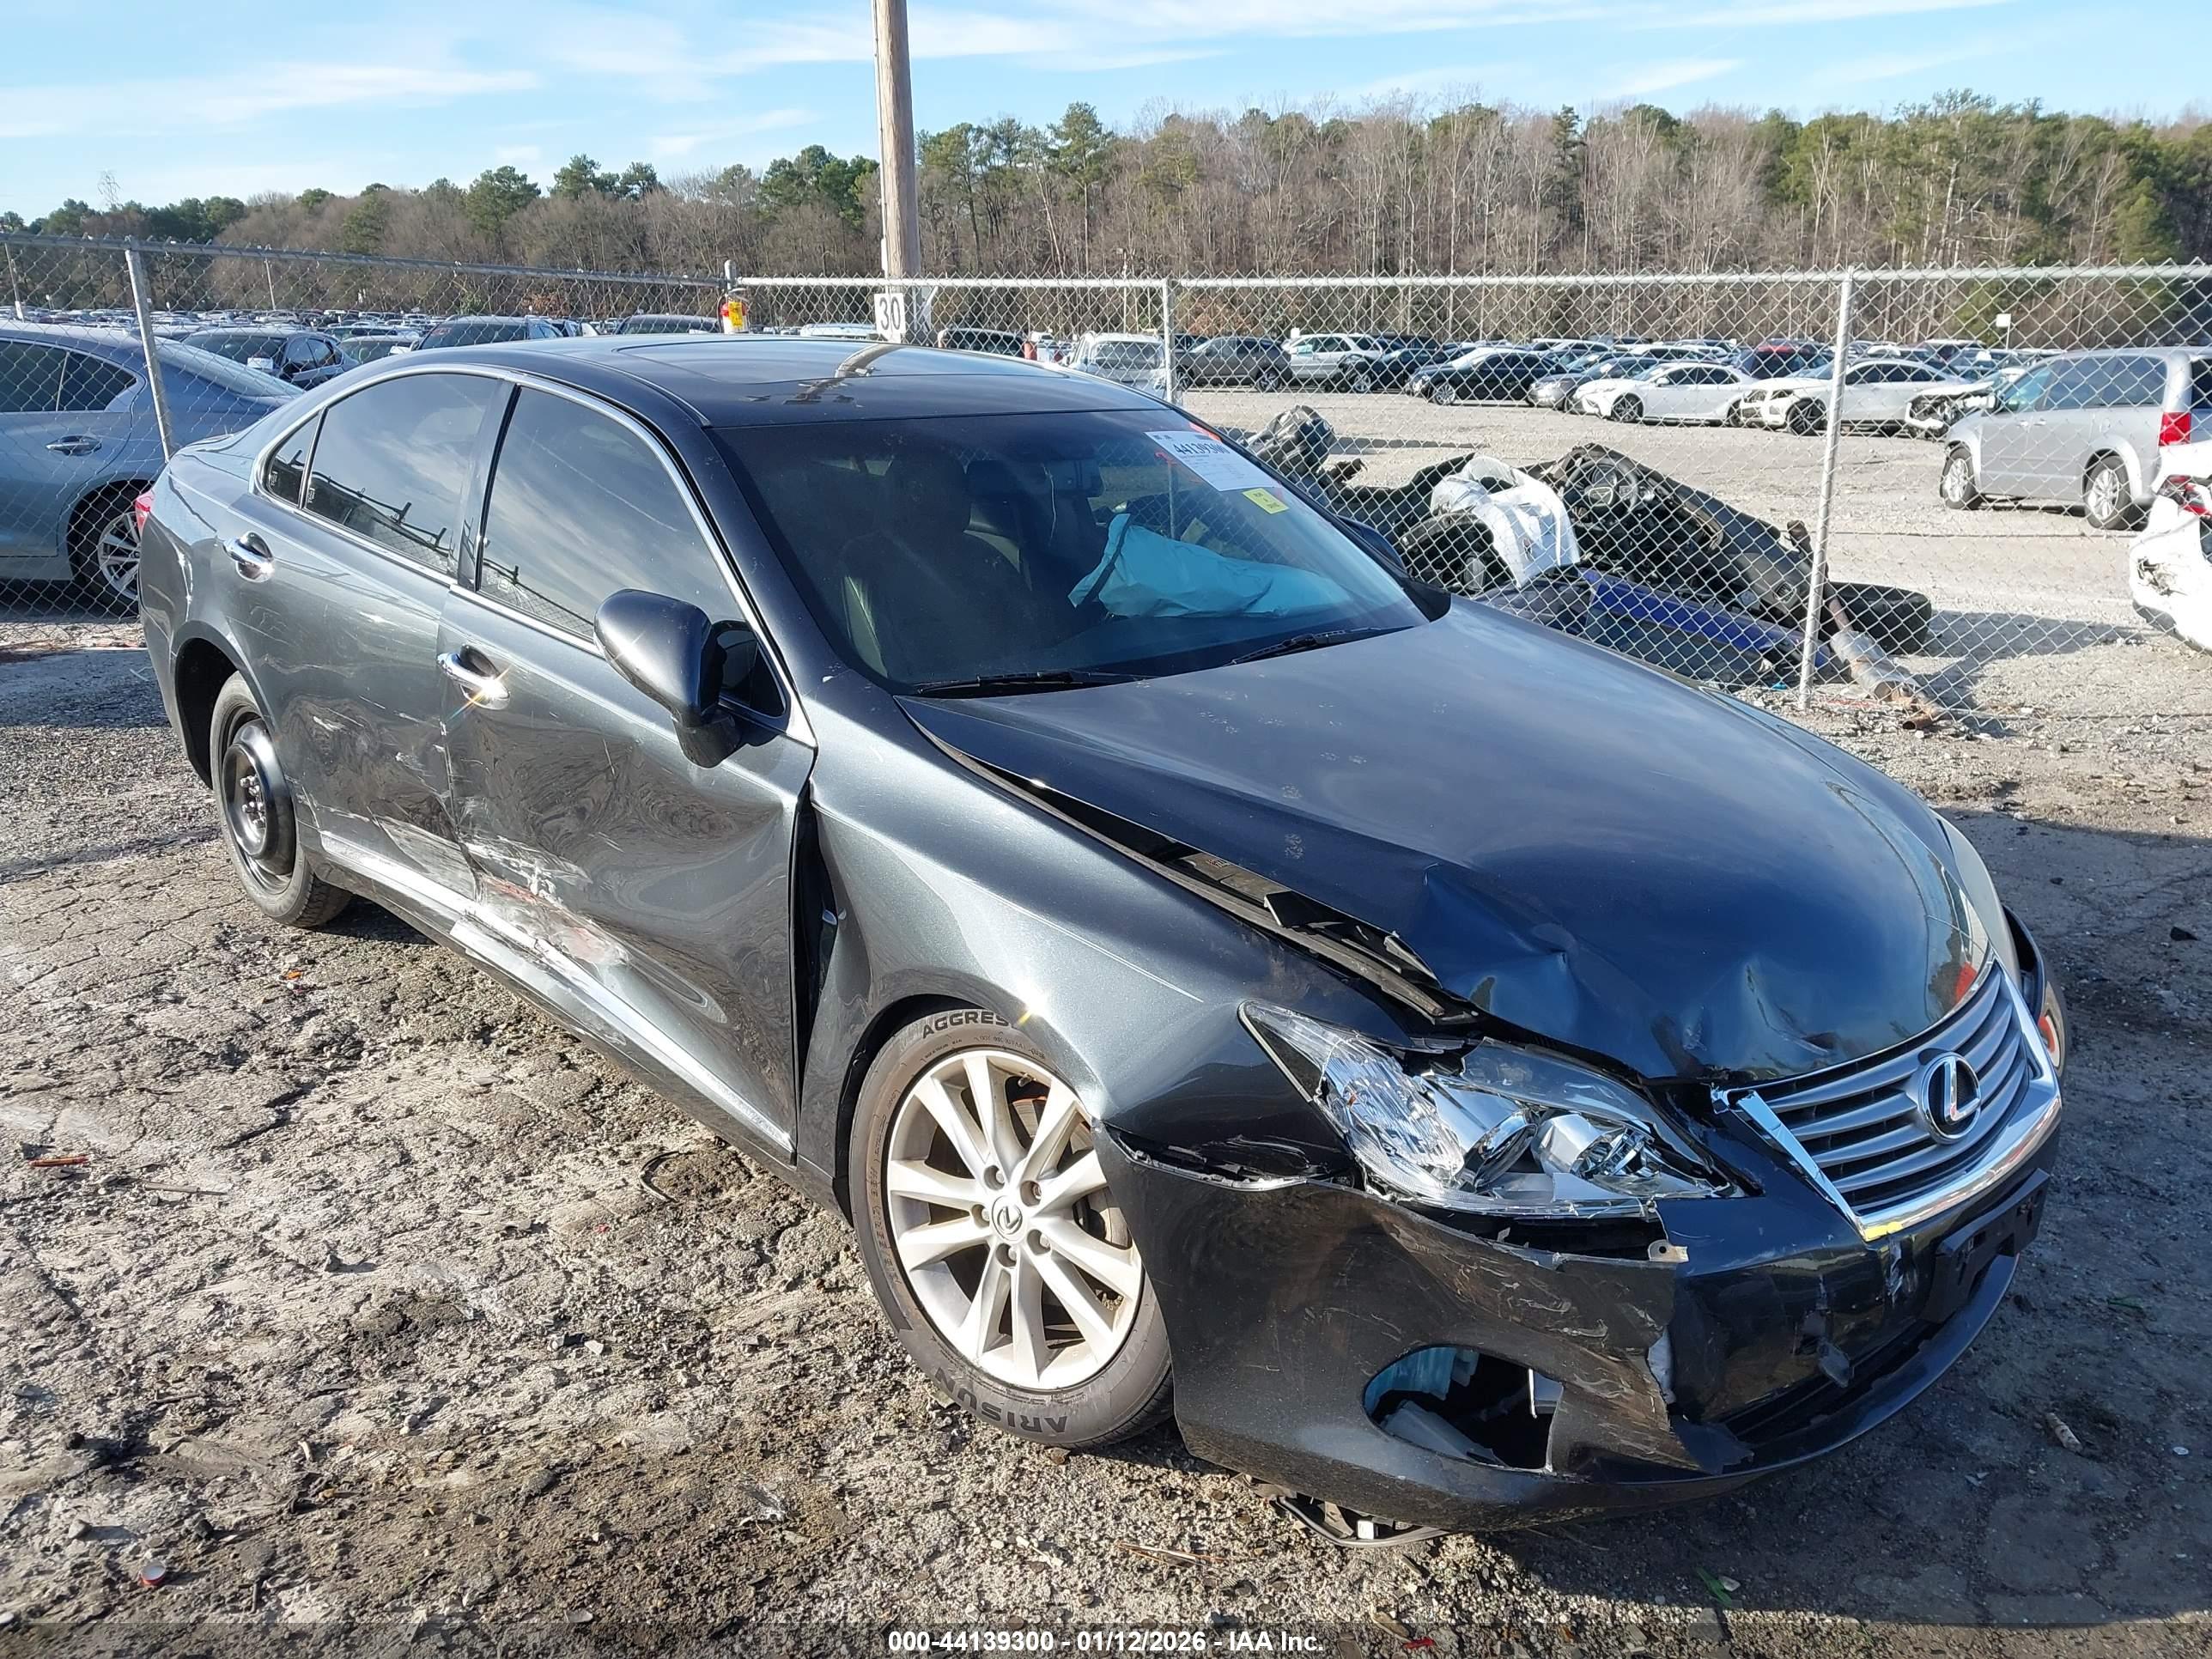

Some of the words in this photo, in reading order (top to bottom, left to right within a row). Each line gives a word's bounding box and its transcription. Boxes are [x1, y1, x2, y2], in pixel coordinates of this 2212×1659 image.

[879, 296, 901, 331] 30
[922, 1012, 1018, 1038] AGGRES
[934, 1366, 1067, 1433] ARISUN
